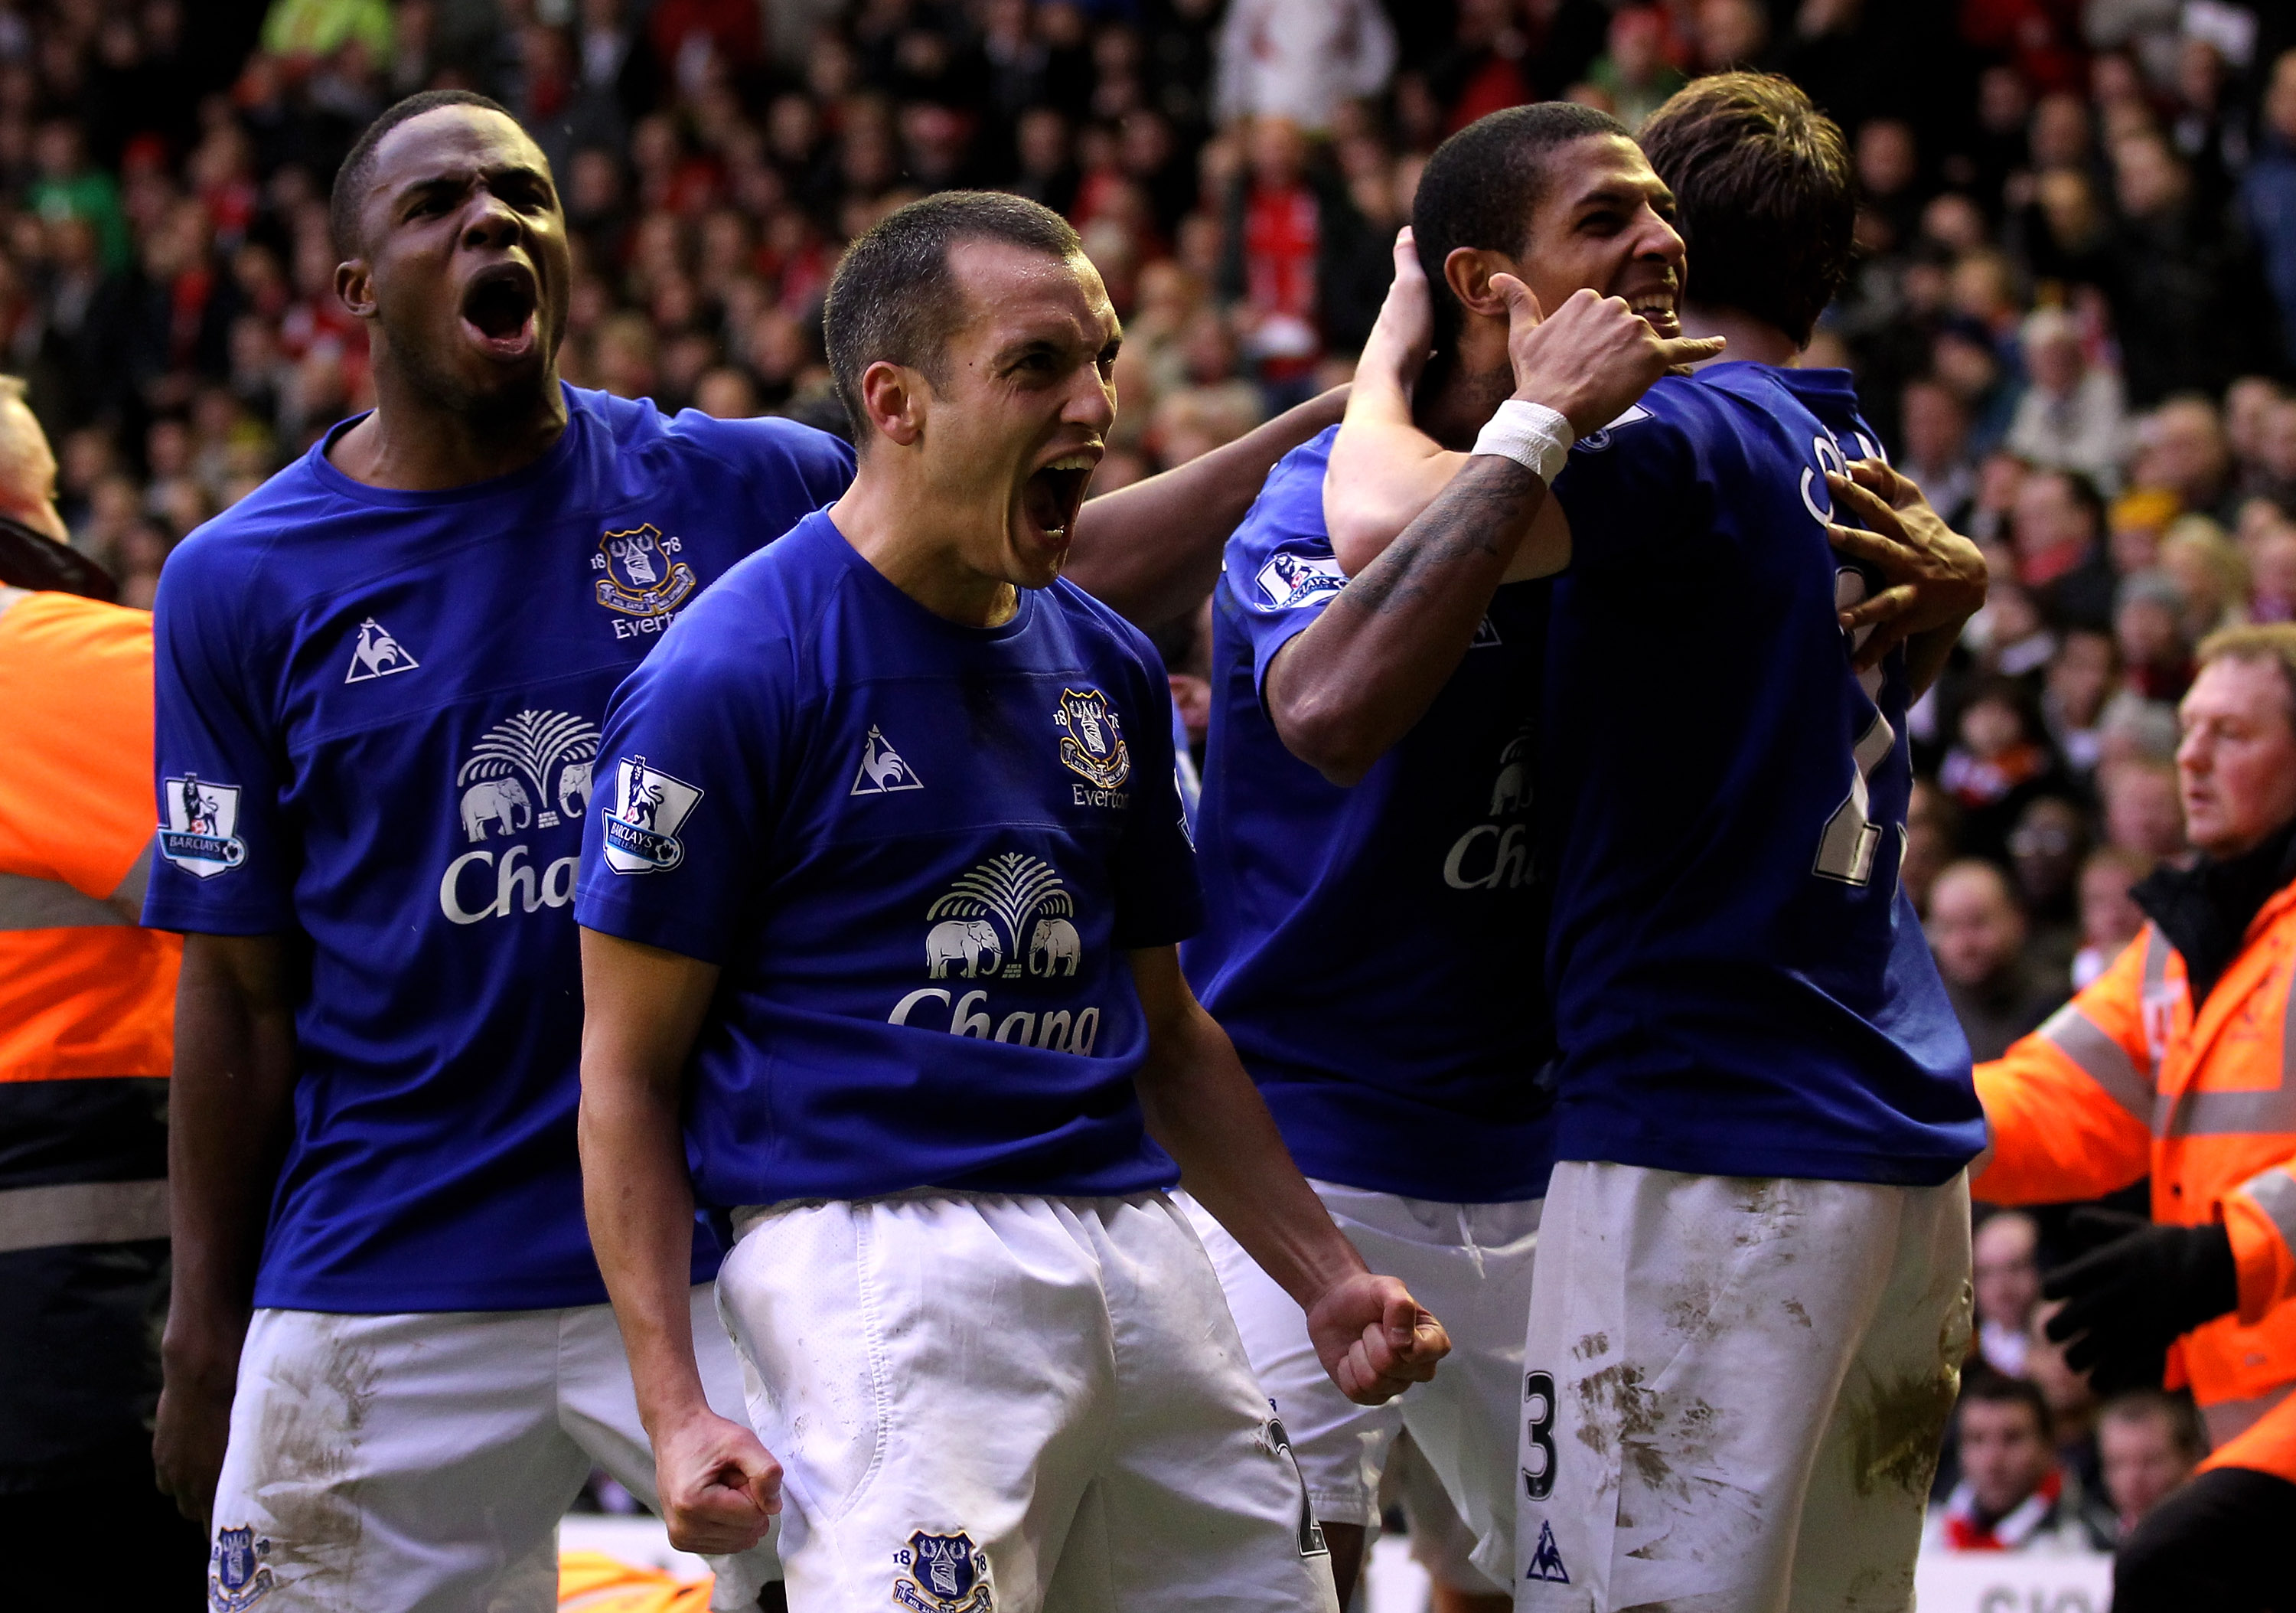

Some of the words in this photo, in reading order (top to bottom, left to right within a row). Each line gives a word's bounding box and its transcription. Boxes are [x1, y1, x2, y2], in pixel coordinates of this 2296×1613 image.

[590, 553, 607, 570] 18
[661, 537, 683, 556] 78
[612, 612, 674, 639] Evert
[1053, 710, 1068, 727] 18
[169, 836, 220, 853] BARCLAYS
[610, 821, 655, 848] BARCLAYS
[440, 845, 581, 925] Cha
[1521, 1370, 1558, 1502] 3
[892, 1549, 912, 1566] 18
[974, 1554, 987, 1572] 78
[908, 1598, 920, 1609] NIL
